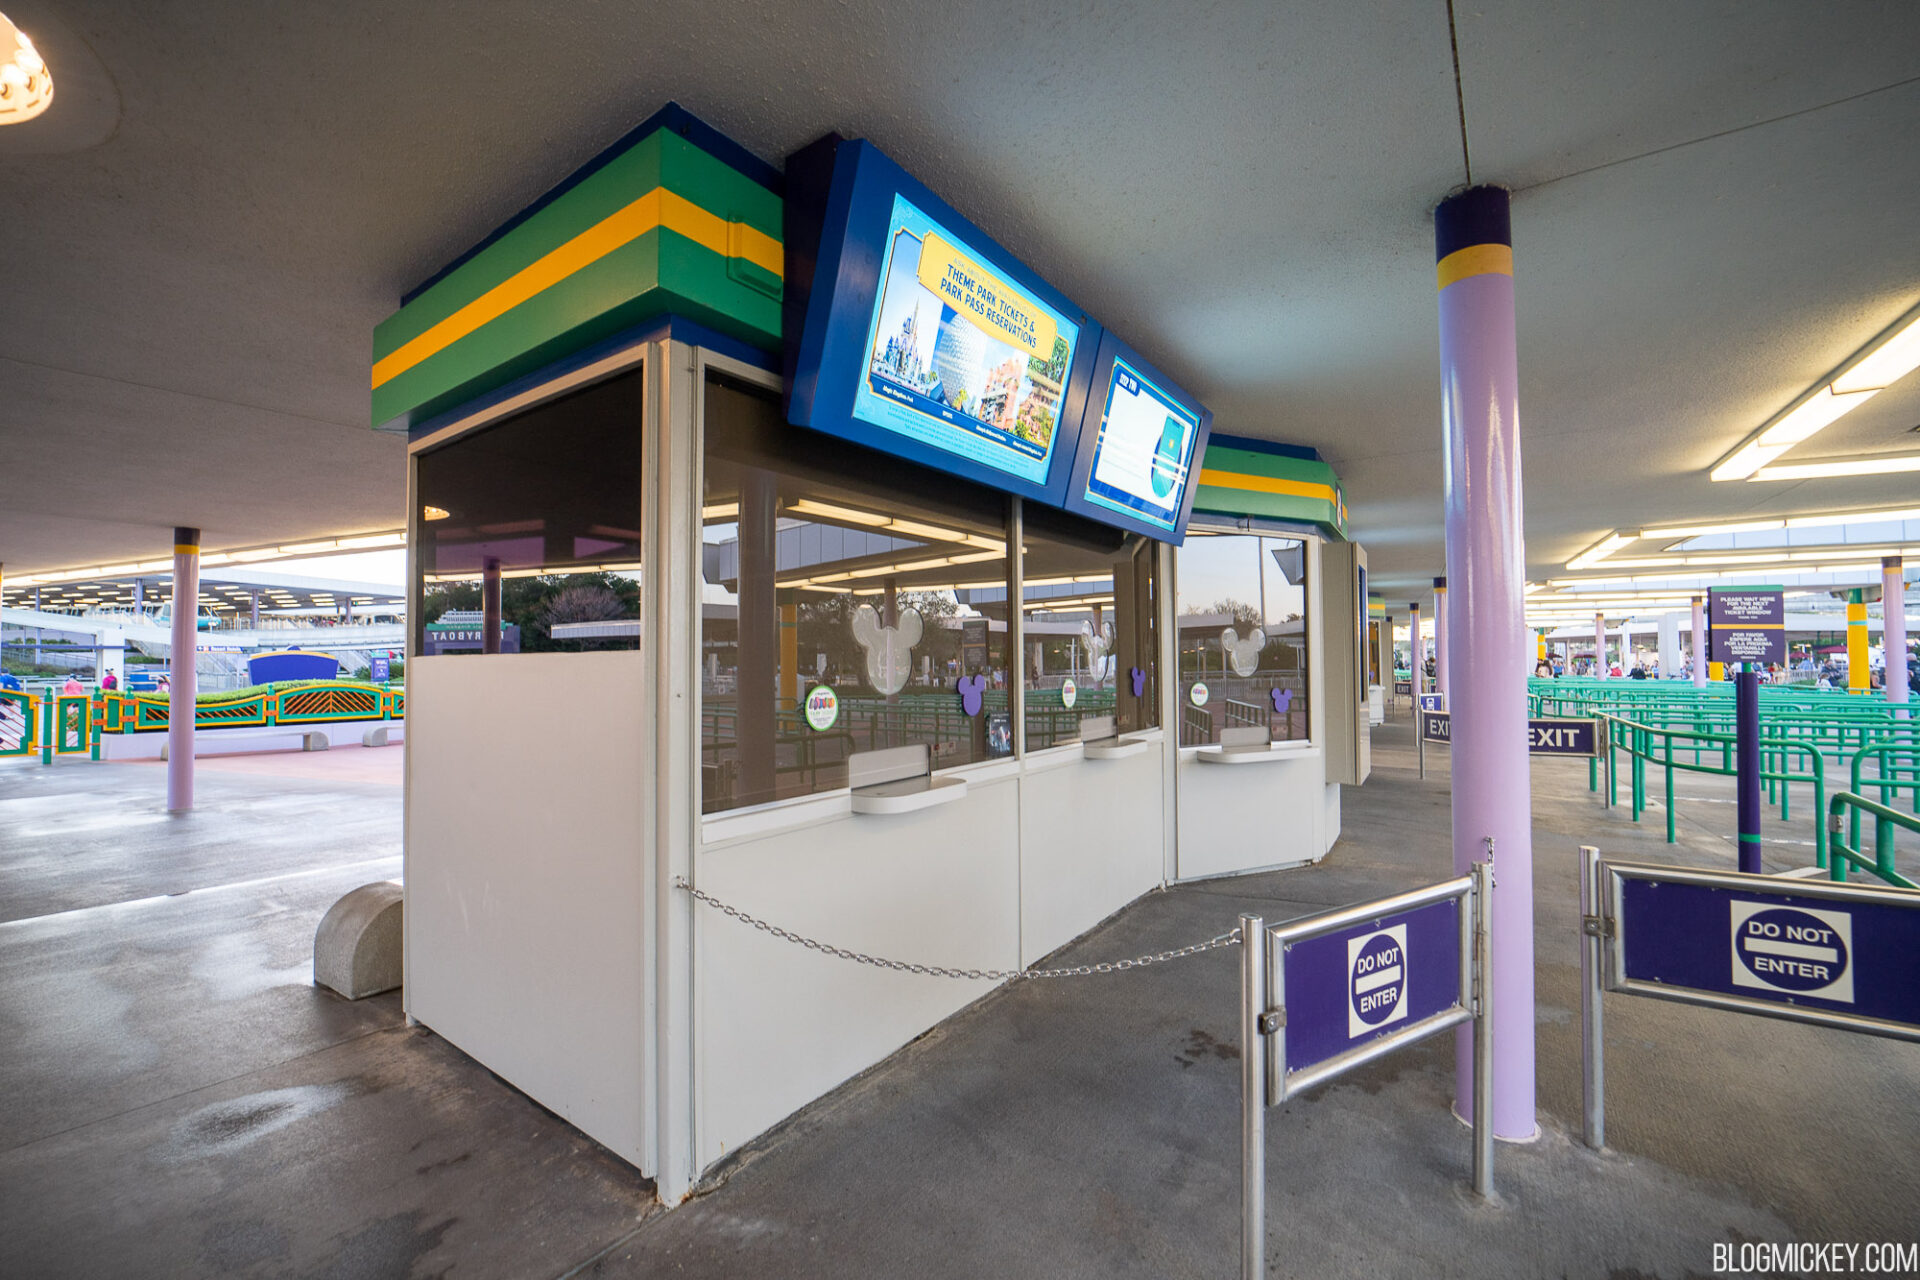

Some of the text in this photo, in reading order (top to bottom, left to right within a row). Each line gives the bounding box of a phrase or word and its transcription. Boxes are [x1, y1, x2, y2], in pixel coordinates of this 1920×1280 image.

[947, 263, 1036, 333] THEME PARK TICKETS &
[940, 277, 1037, 349] PARK PASS RESERVATIONS
[1336, 488, 1342, 527] 8
[1397, 685, 1409, 693] EXIT
[1429, 719, 1450, 736] EXI
[1748, 920, 1833, 944] DO NOT
[1357, 947, 1399, 974] DO NOT
[1754, 956, 1829, 980] ENTER
[1360, 986, 1397, 1013] ENTER
